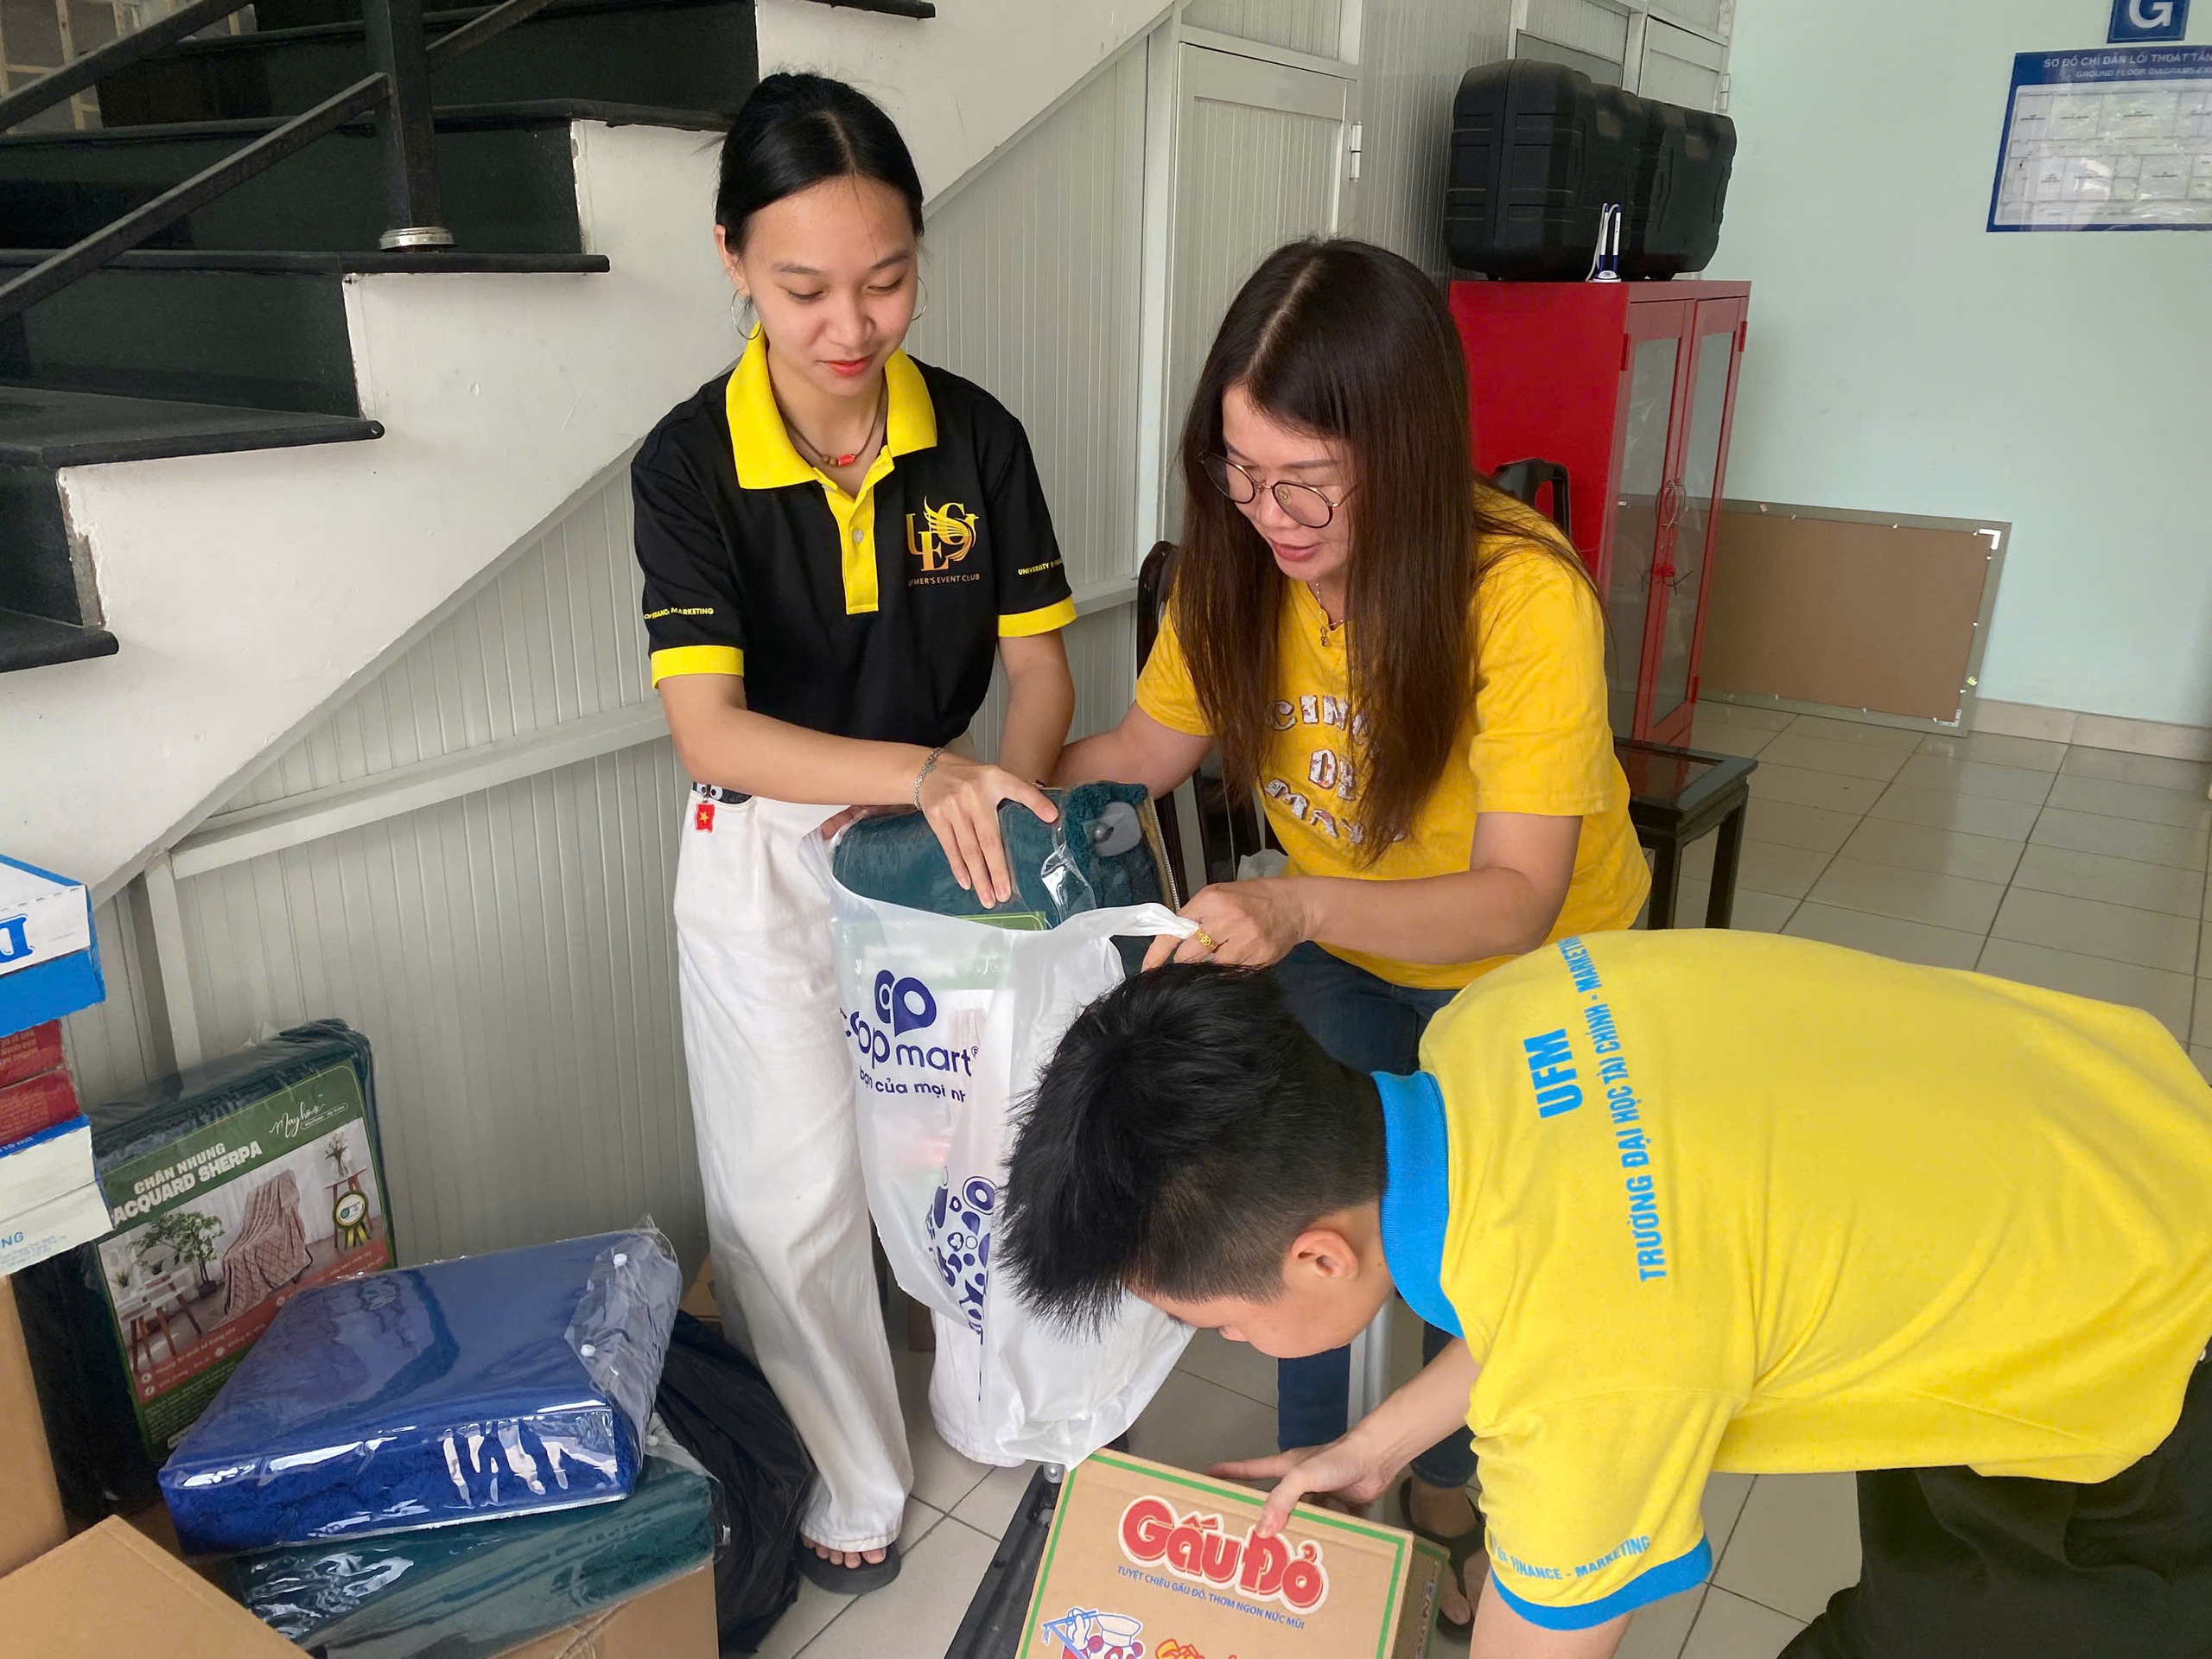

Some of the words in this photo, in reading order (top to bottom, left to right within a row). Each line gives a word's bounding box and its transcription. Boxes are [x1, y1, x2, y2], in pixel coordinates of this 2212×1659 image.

[2128, 0, 2173, 29] G
[937, 575, 961, 584] EVENT
[962, 573, 980, 582] CLUB
[875, 1078, 908, 1094] của
[914, 1084, 946, 1098] mọi
[1523, 1028, 1584, 1119] UFM
[1607, 1085, 1643, 1124] HỌC
[176, 1142, 226, 1174] NHUNG
[1615, 1128, 1651, 1168] ĐẠI
[113, 1173, 196, 1225] ACQUARD
[198, 1141, 263, 1182] SHERPA
[1510, 1555, 1562, 1580] FINANCE
[1575, 1535, 1650, 1578] MARKETING
[1236, 1602, 1263, 1618] NGON
